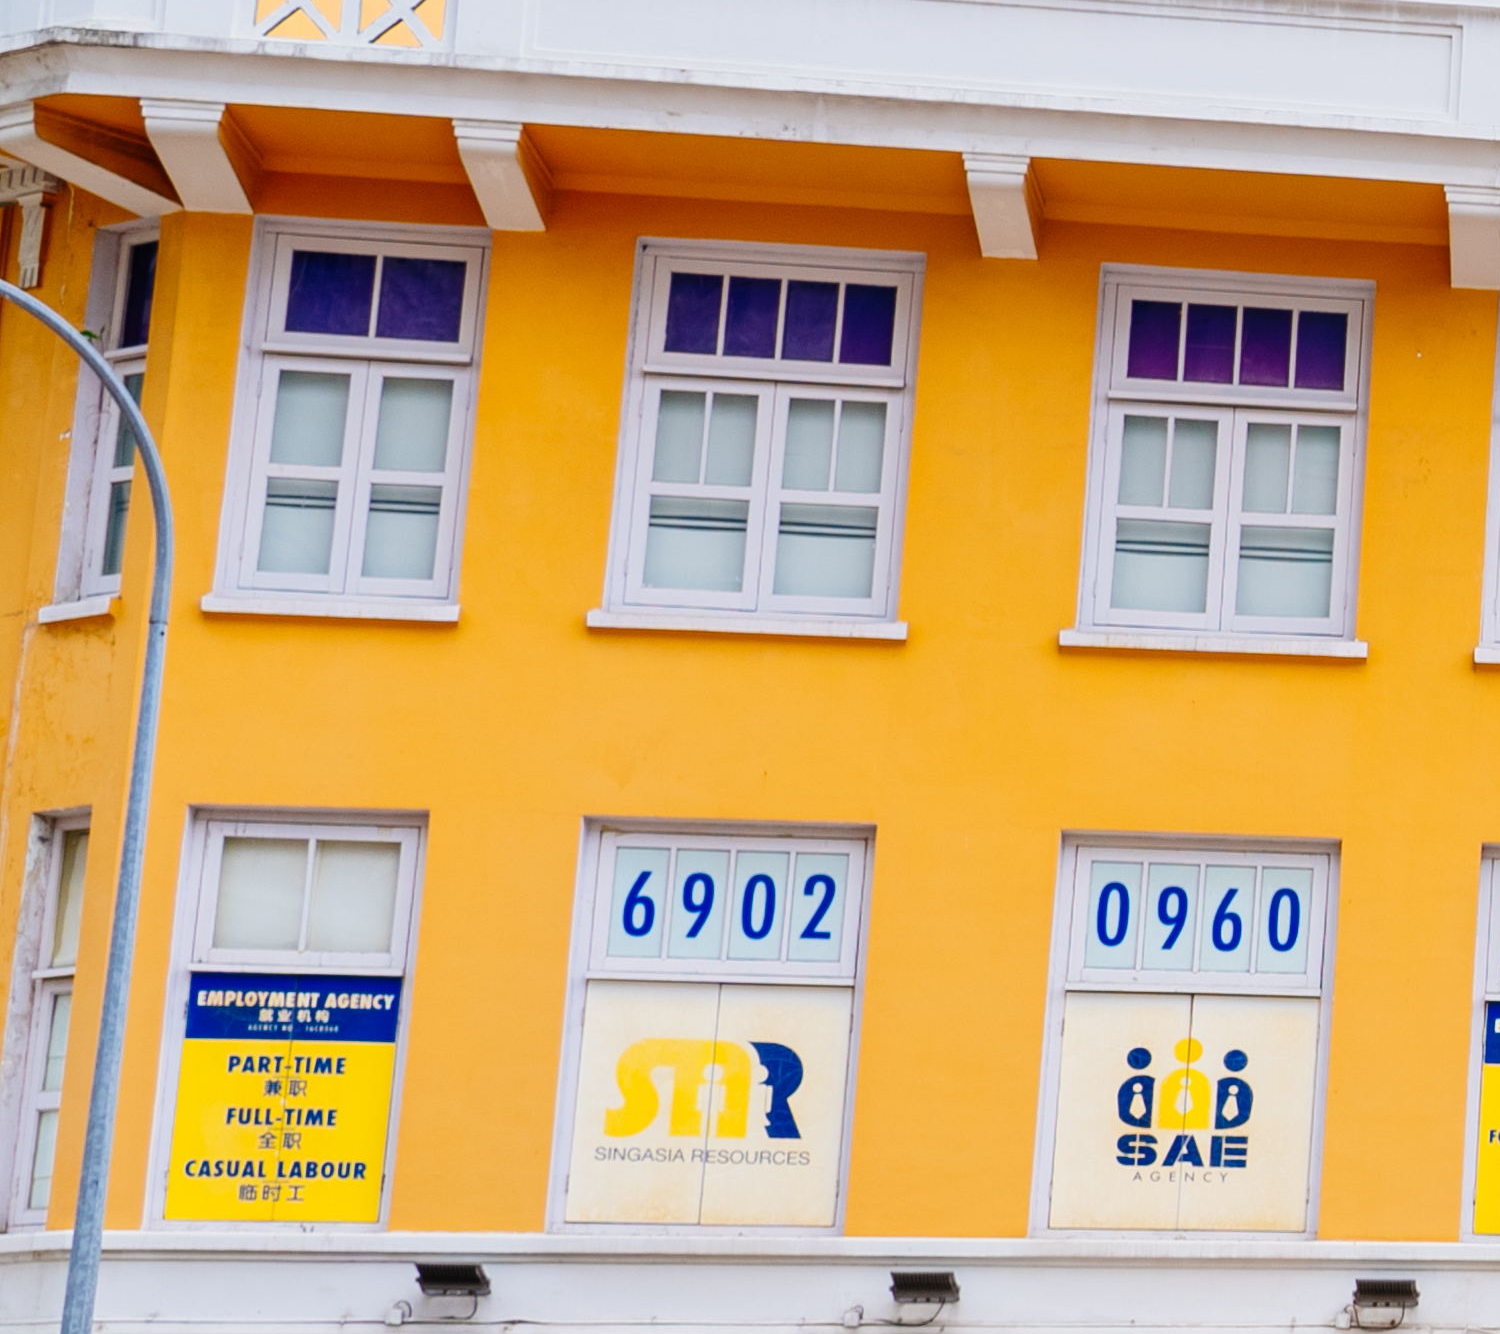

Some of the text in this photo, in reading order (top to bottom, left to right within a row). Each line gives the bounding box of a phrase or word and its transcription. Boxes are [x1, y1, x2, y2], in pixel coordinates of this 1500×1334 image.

[622, 870, 836, 940] 6902
[1096, 881, 1300, 952] 0960
[197, 990, 395, 1010] EMPLOYMENT AGENCY
[227, 1055, 347, 1075] PART-TIME
[263, 1079, 307, 1097] 兼职
[225, 1107, 338, 1127] FULL-TIME
[258, 1131, 302, 1150] 全职
[1116, 1133, 1249, 1168] SAE
[594, 1146, 811, 1166] SINGASIA RESOURCES
[184, 1159, 367, 1180] CASUAL LABOUR
[1132, 1170, 1229, 1183] AGENCY
[238, 1184, 305, 1202] 临时工
